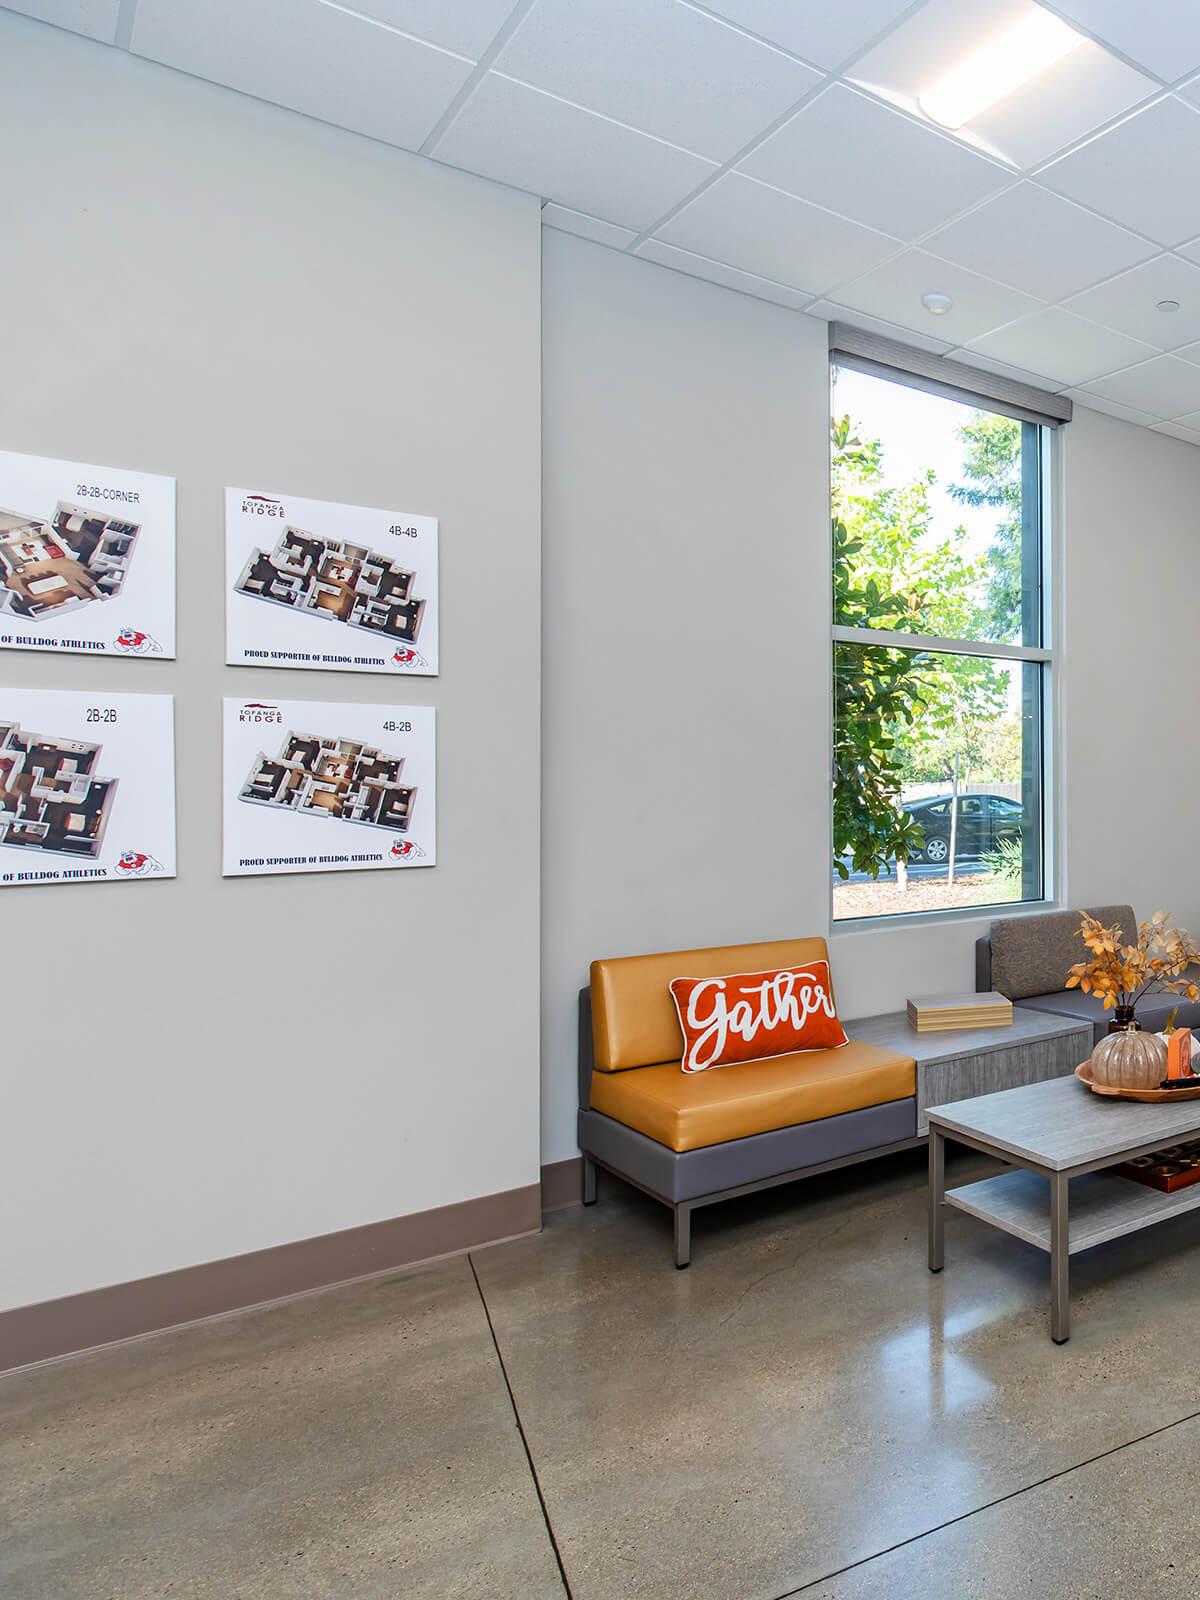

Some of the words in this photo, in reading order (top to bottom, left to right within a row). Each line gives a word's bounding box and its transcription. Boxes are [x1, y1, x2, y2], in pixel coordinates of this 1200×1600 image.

[76, 484, 140, 503] 2B-2B-CORNER
[241, 505, 286, 518] RIDGE
[388, 525, 418, 538] 4B-4B
[1, 635, 13, 643] OF
[16, 636, 58, 646] BULLDOG
[60, 640, 105, 649] ATHLETICS
[244, 650, 269, 658] PROUD
[270, 651, 311, 661] SUPPORTER
[322, 655, 352, 664] BULLDOG
[353, 657, 386, 666] ATHLETICS
[86, 708, 117, 723] 2B-2B
[239, 715, 283, 723] RIDGE
[382, 721, 412, 732] 4B-2B
[239, 858, 265, 866] PROUD
[266, 856, 307, 865] SUPPORTER
[318, 854, 349, 863] BULLDOG
[2, 873, 15, 881] OF
[17, 871, 60, 881] BULLDOG
[62, 869, 107, 878] ATHLETICS
[687, 971, 836, 1071] Gather
